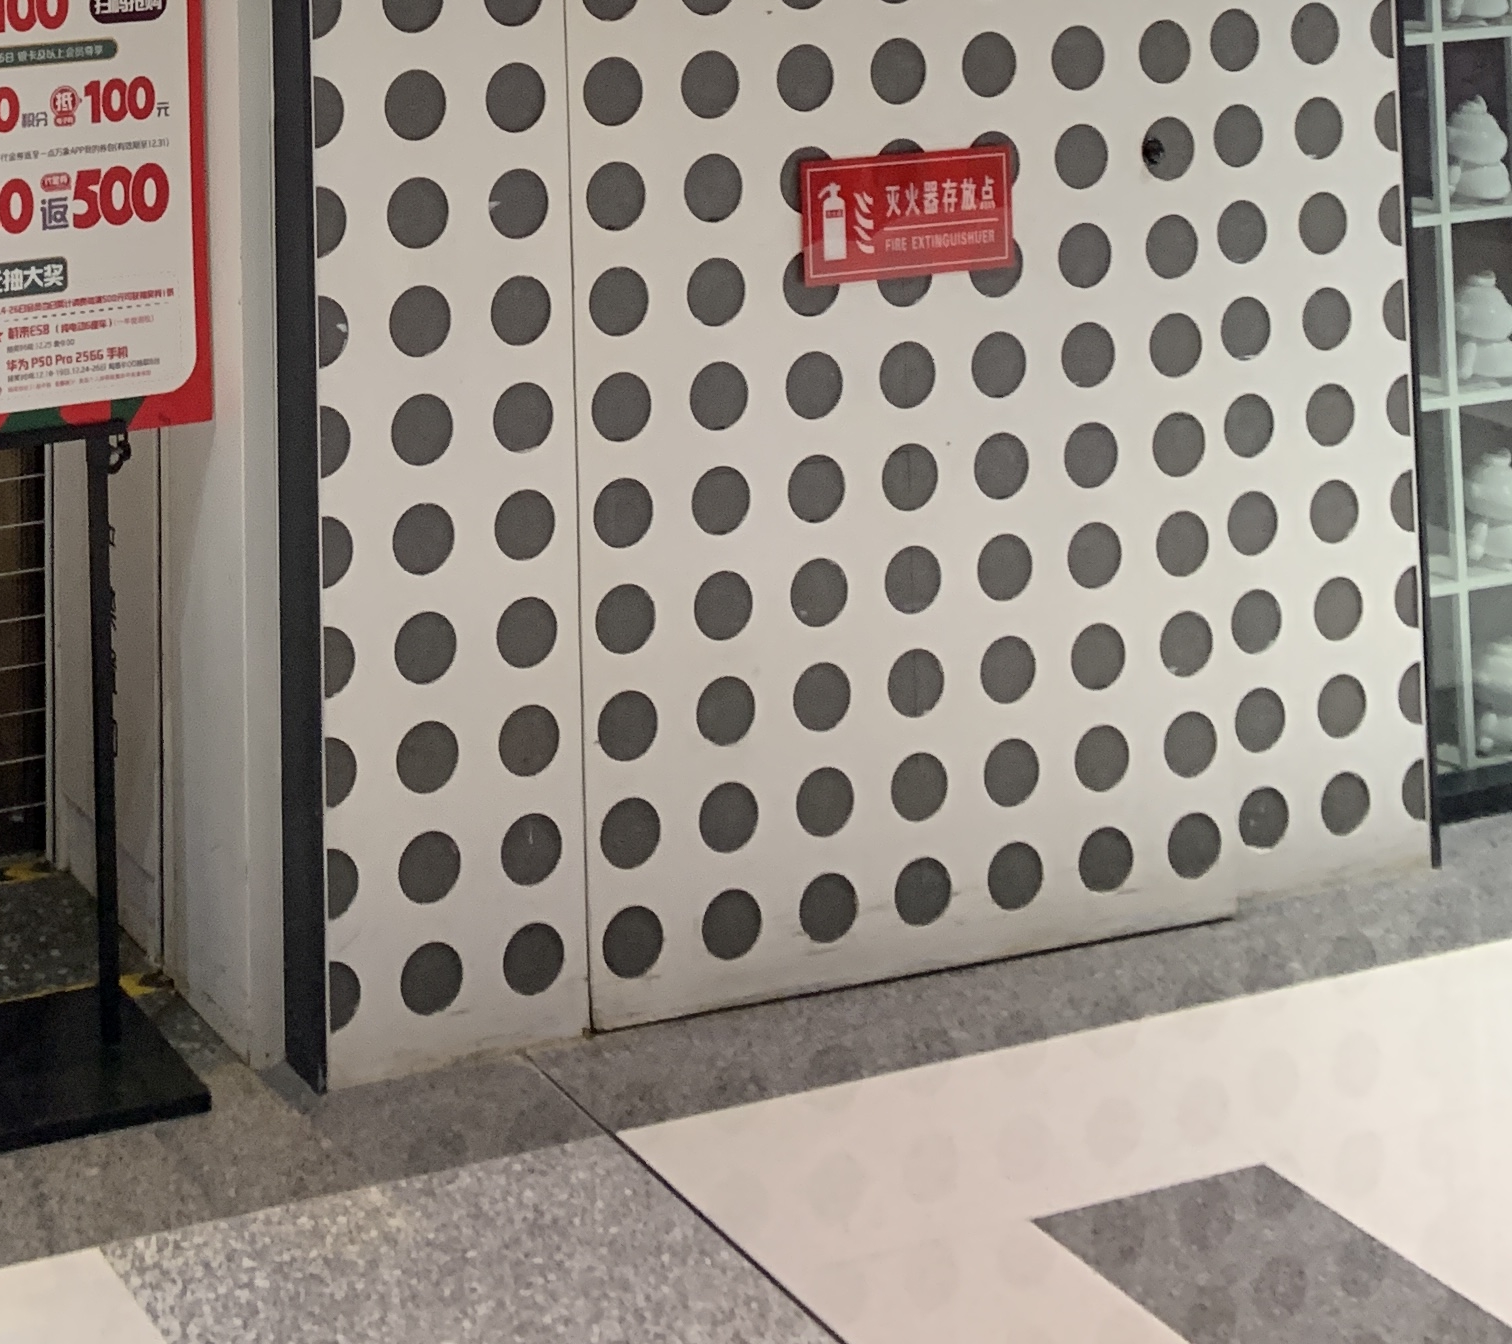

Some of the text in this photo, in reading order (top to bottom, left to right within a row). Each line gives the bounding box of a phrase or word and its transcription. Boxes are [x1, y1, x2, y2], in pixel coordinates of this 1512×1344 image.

[21, 112, 48, 128] 积分
[55, 91, 73, 111] 抵
[84, 75, 156, 124] 100
[156, 101, 170, 118] 元
[40, 197, 69, 231] 返
[72, 162, 170, 229] 500
[884, 175, 995, 217] 灭火器存放点
[885, 237, 908, 252] FIRE
[6, 346, 129, 373] 华为 P50 Pro 256G 手机
